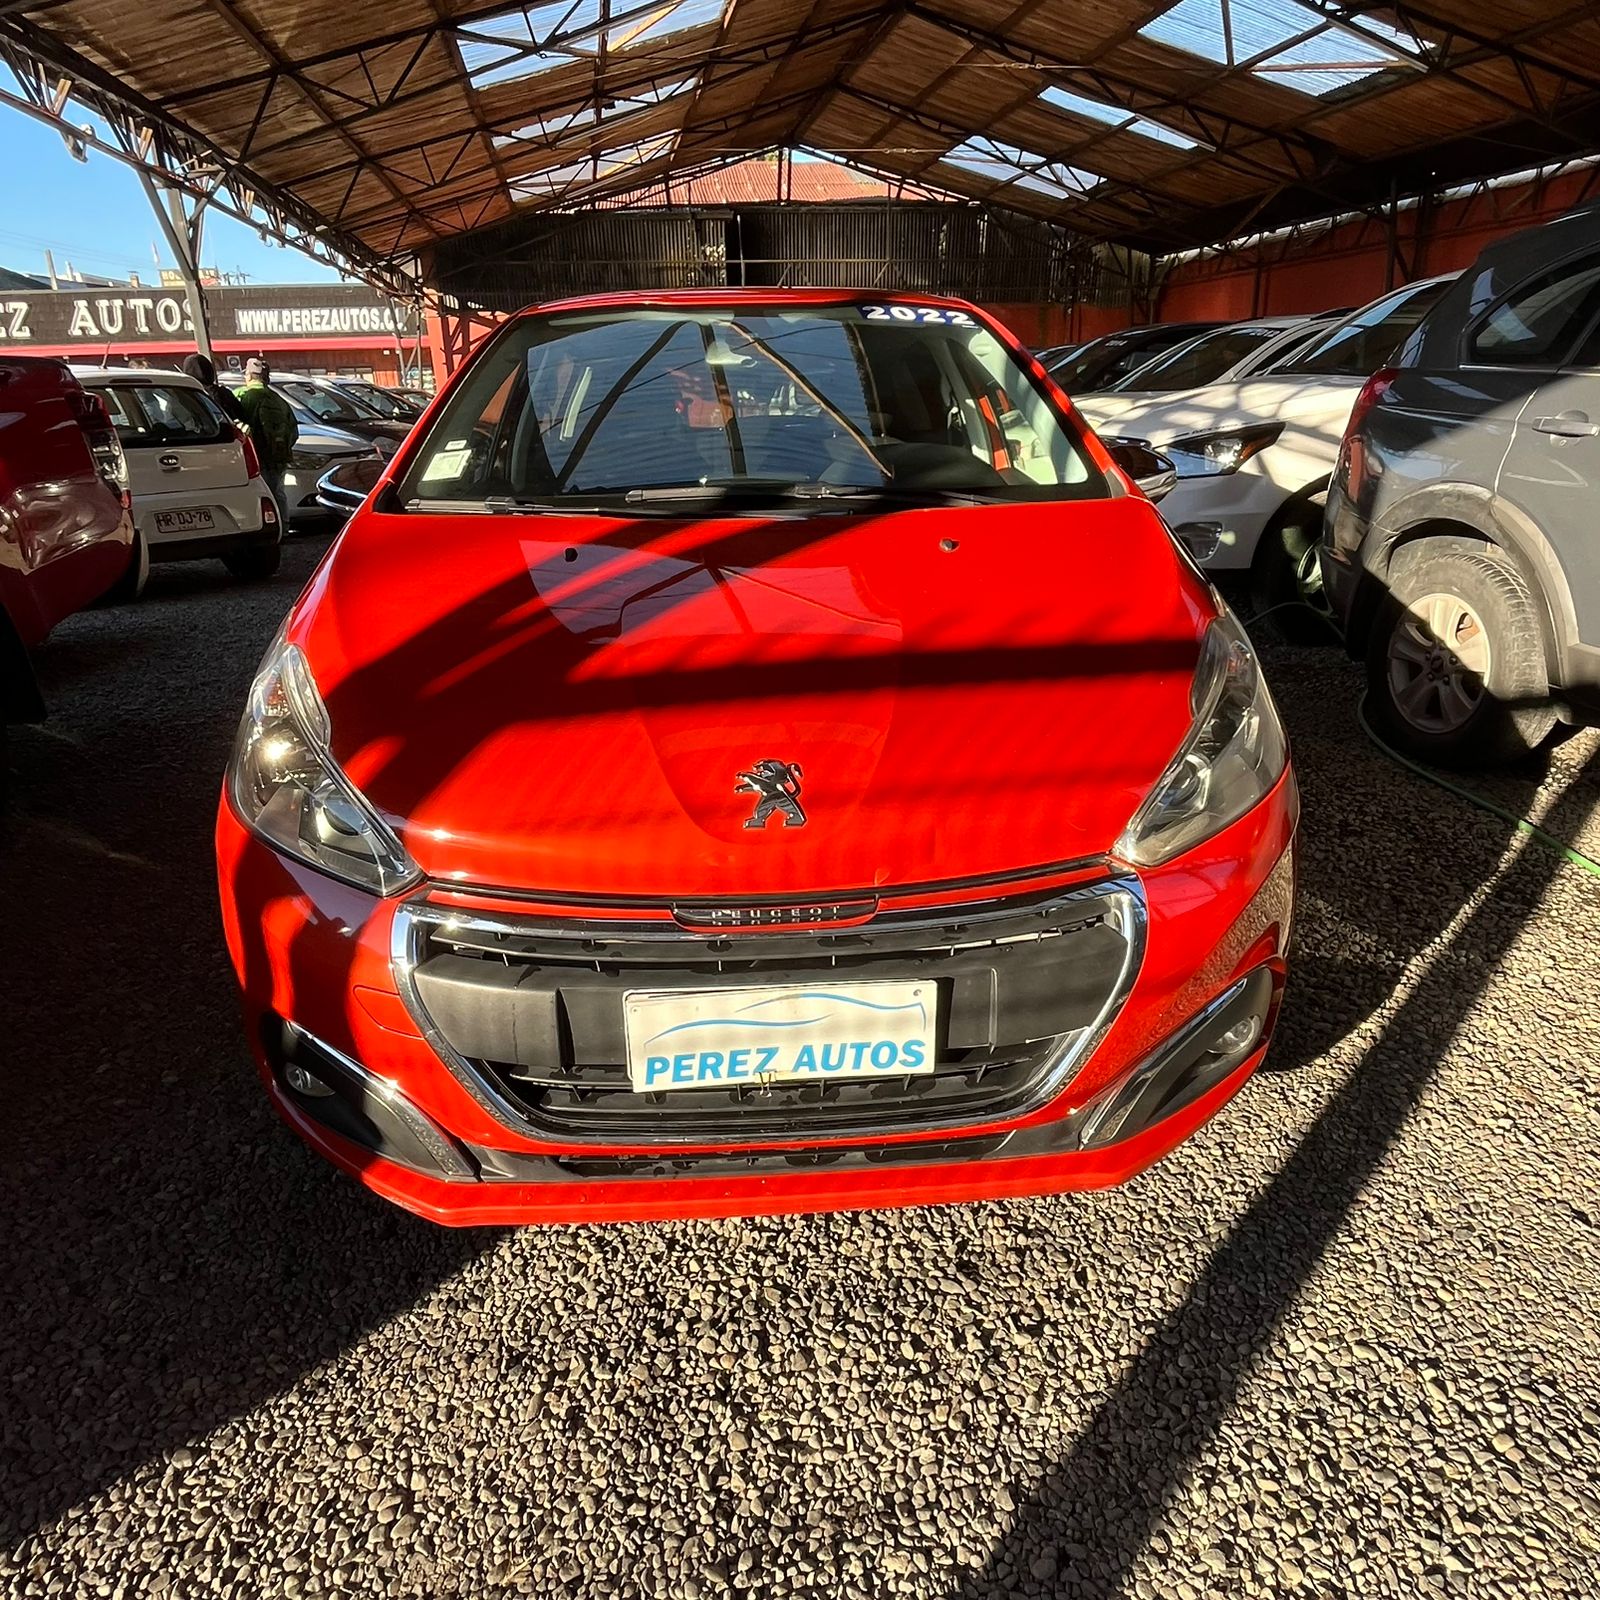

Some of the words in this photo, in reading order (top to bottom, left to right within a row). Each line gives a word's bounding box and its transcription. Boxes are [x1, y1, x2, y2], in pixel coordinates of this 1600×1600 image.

[0, 302, 31, 338] Z
[862, 306, 976, 325] 2022
[711, 905, 840, 920] PEUGEOT
[645, 1046, 780, 1085] PEREZ
[792, 1039, 926, 1073] AUTOS
